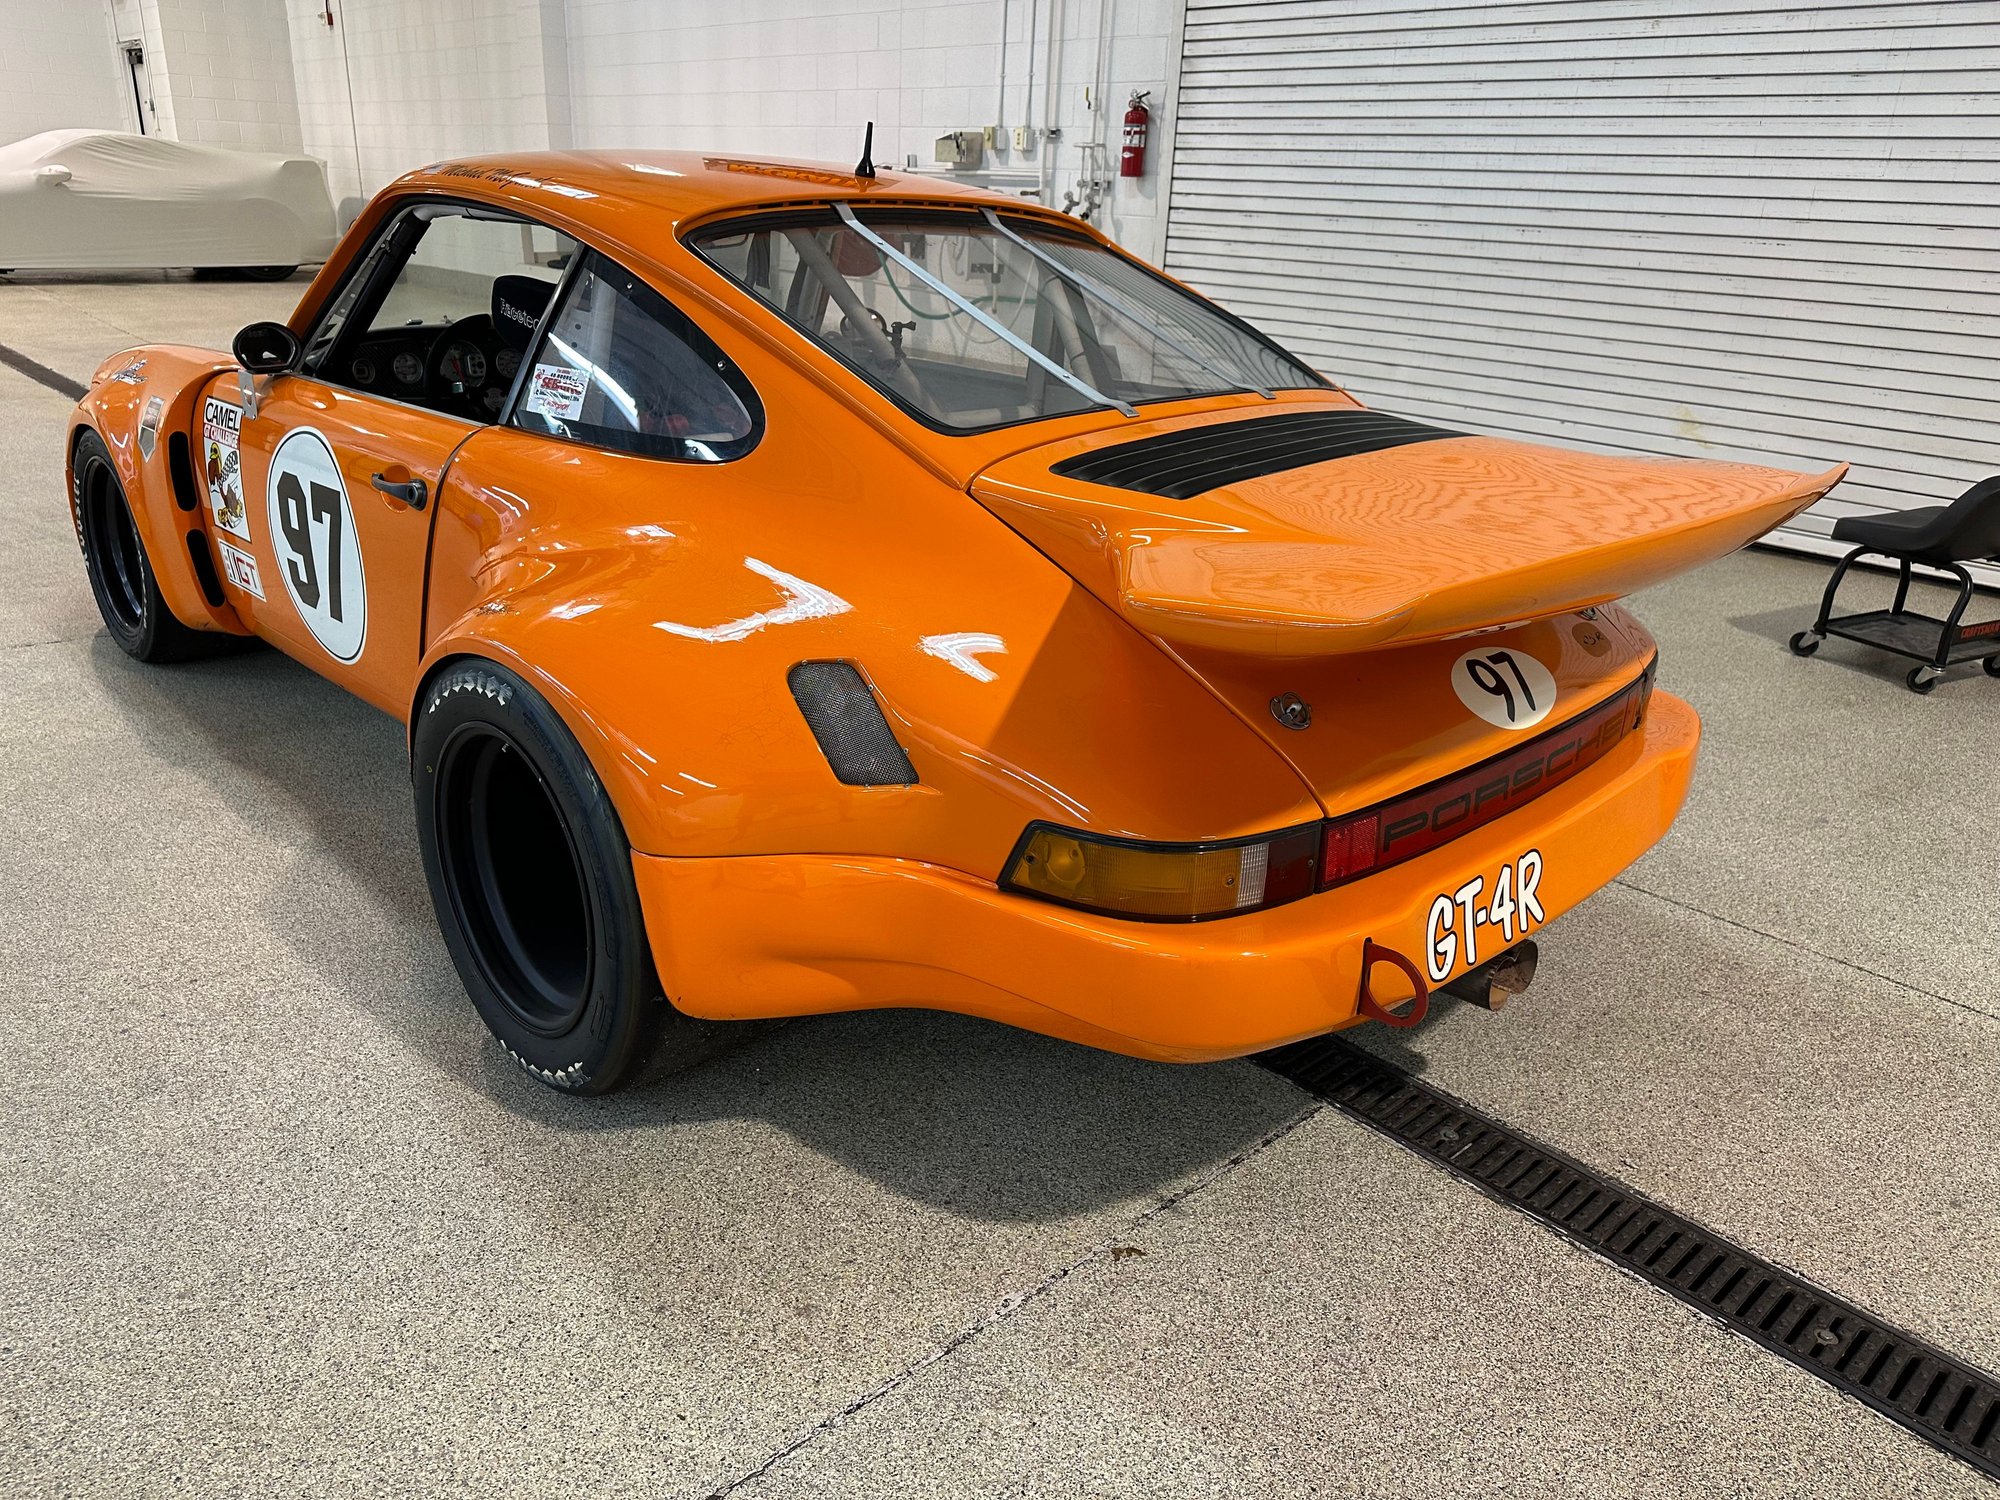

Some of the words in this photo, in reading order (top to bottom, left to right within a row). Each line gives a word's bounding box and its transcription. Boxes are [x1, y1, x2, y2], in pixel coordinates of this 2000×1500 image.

[205, 402, 239, 432] CAMEL
[211, 426, 239, 449] CHALLENGE
[276, 471, 343, 623] 97
[1465, 650, 1536, 723] 97
[1383, 718, 1623, 853] PORSCHE
[1425, 848, 1546, 983] GT-4R
